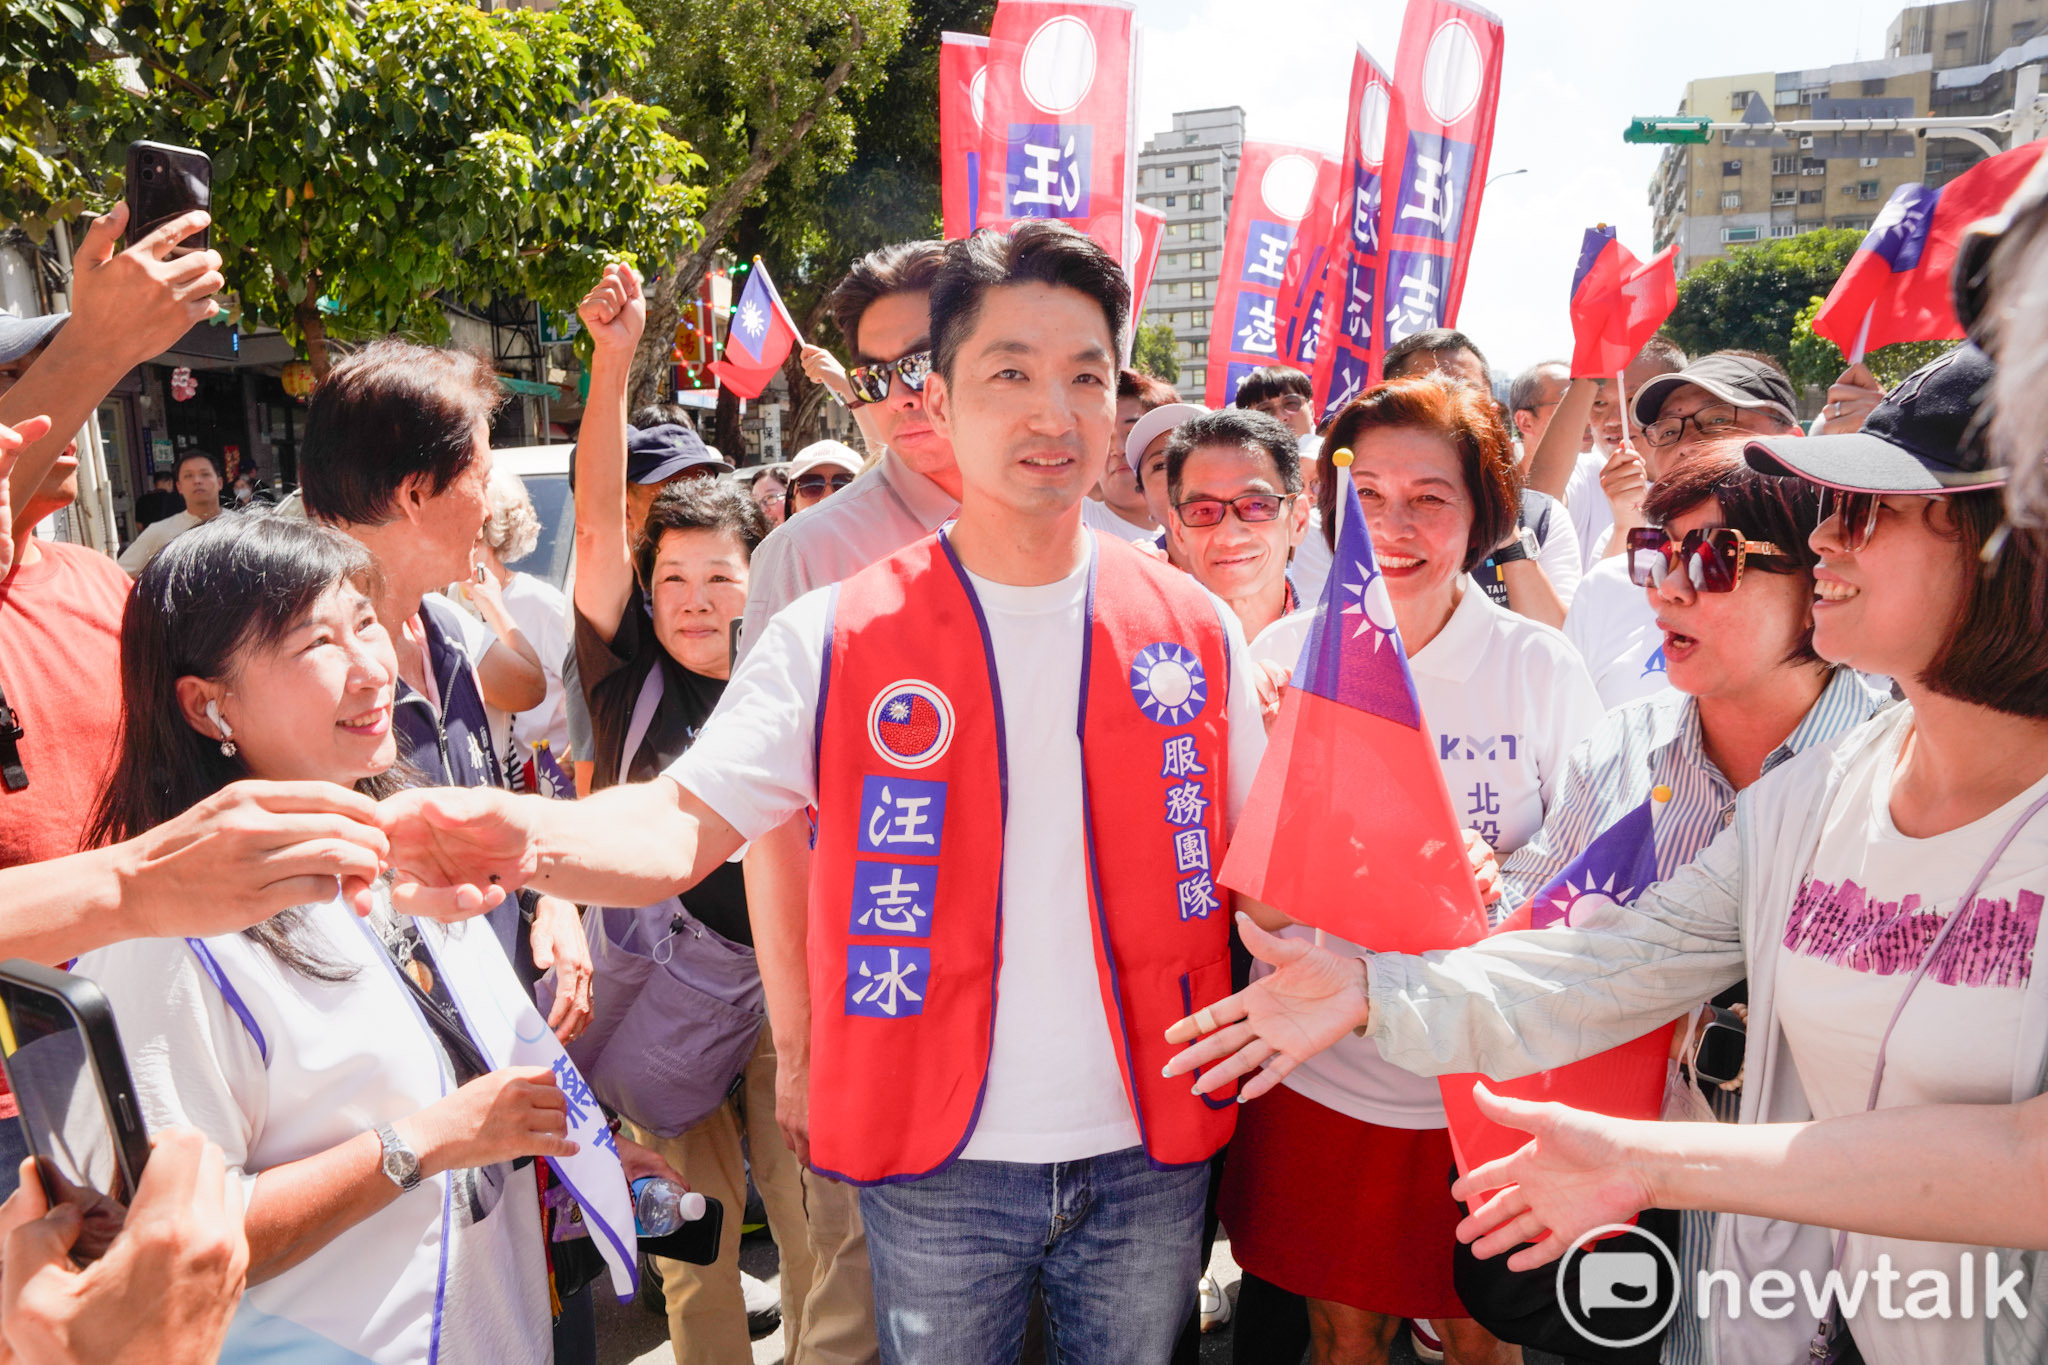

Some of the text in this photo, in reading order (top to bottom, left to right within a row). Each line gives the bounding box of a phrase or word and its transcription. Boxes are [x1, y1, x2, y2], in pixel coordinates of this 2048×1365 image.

[1161, 735, 1220, 920] 服務團隊
[1440, 734, 1524, 760] KMT
[852, 785, 936, 1015] 汪志冰
